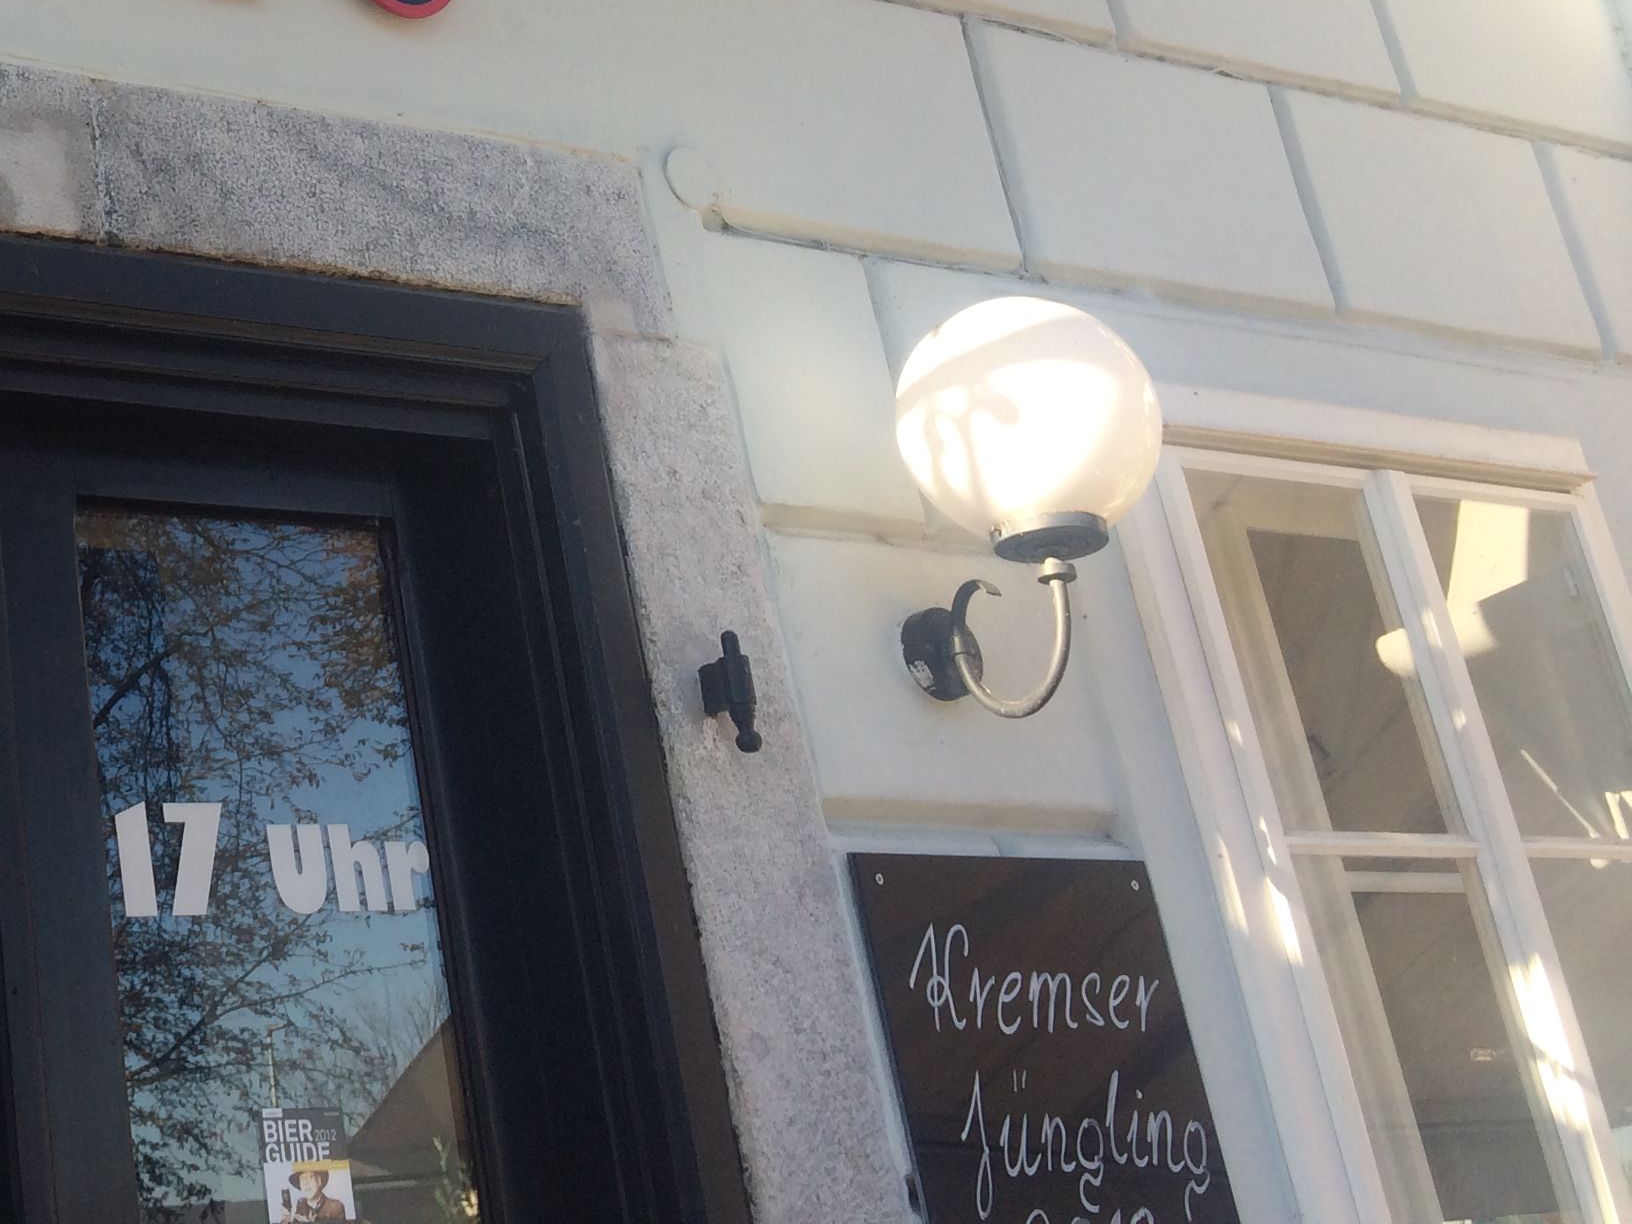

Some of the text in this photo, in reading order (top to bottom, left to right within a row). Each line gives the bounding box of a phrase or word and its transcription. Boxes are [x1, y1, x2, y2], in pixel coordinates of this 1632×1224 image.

[114, 800, 223, 917] 17
[266, 823, 430, 915] Uhr
[909, 922, 1159, 1036] Kremser
[262, 1119, 337, 1143] BIER 2012
[265, 1142, 330, 1164] GUIDE
[961, 1069, 1210, 1222] Jüngling
